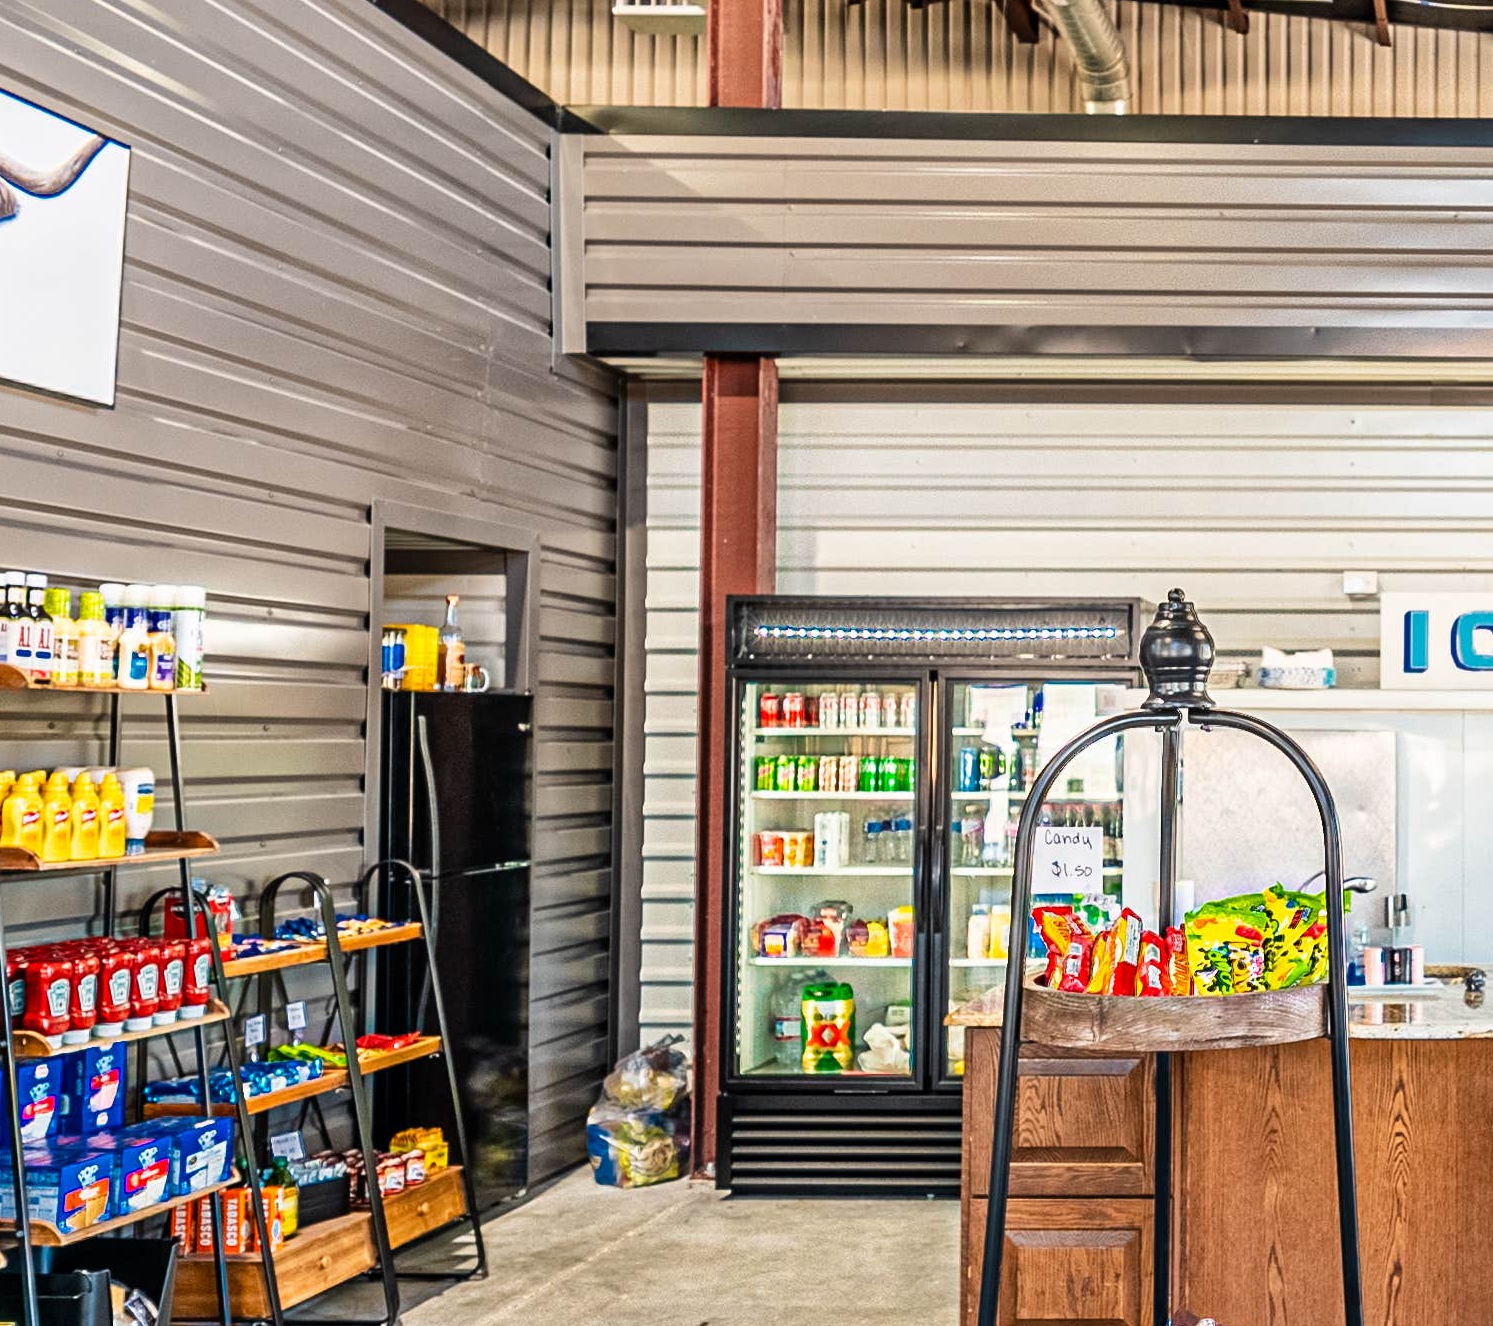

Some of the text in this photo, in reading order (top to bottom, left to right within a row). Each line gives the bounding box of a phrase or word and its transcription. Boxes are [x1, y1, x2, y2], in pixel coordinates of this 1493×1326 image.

[1044, 829, 1093, 850] Candy
[1051, 861, 1093, 878] $1.50
[226, 1198, 239, 1247] TABASCO
